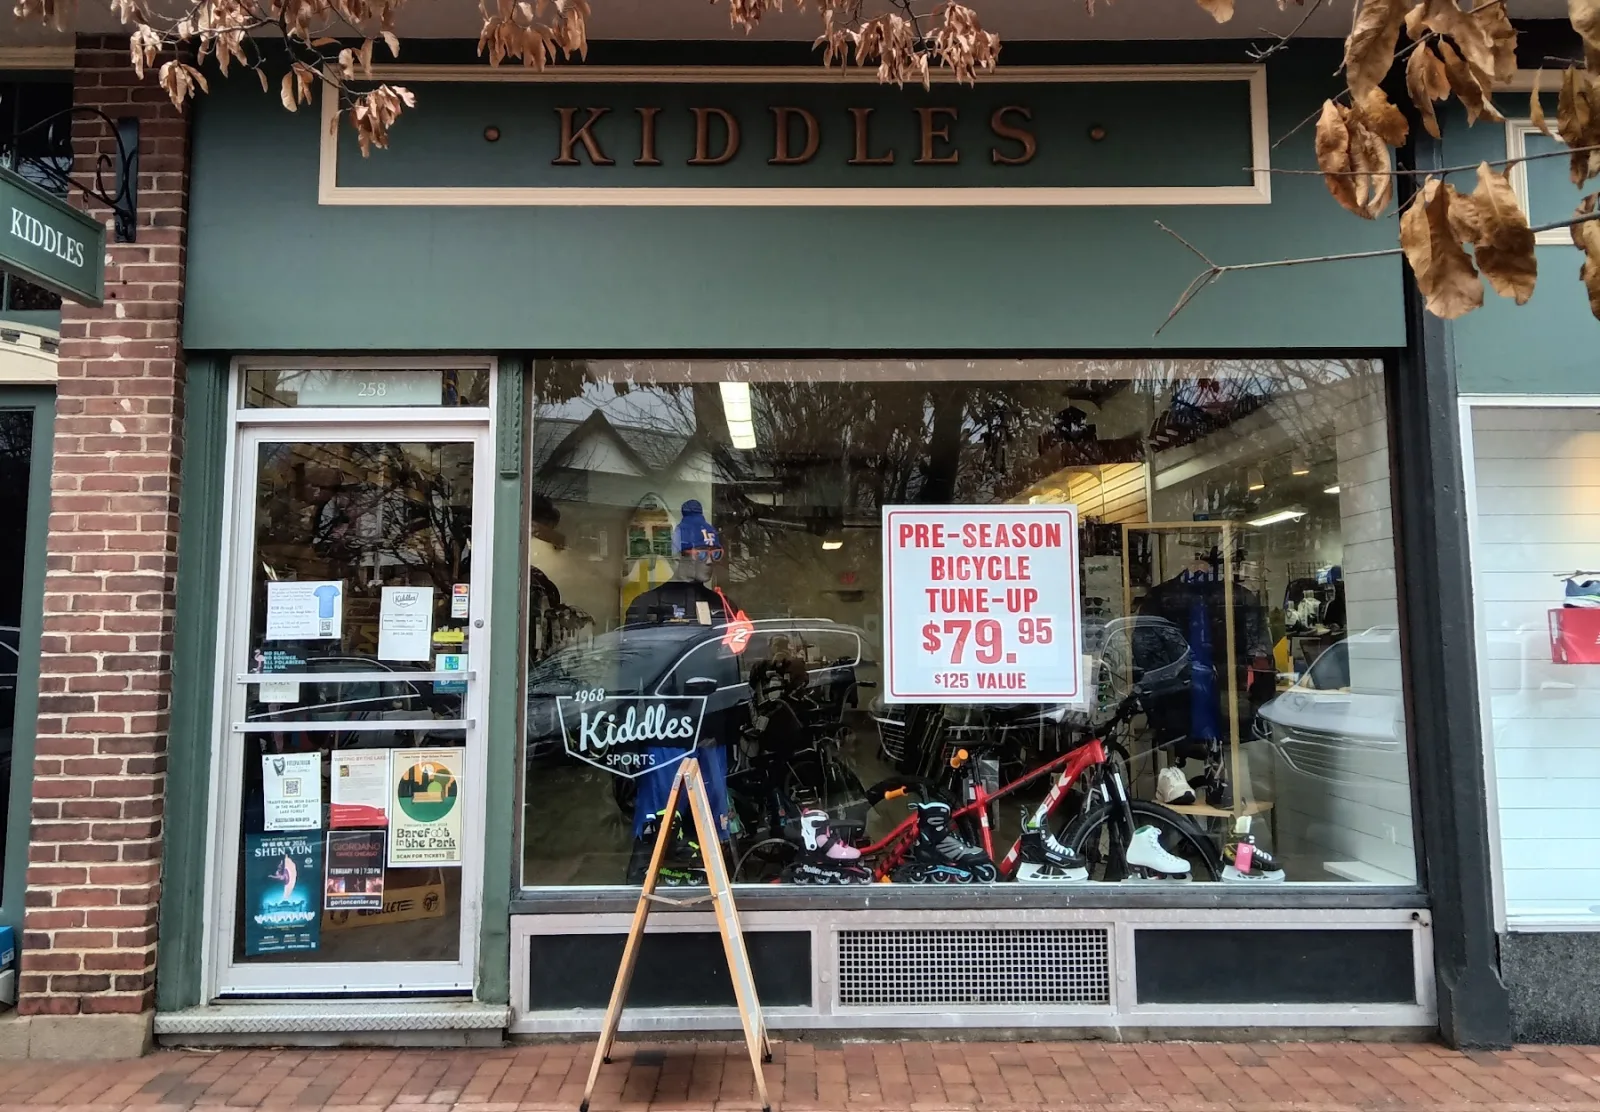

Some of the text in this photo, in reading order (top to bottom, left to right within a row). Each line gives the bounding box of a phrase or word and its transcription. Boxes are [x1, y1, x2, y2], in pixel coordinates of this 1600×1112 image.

[551, 105, 1038, 167] KIDDLES
[10, 207, 84, 268] KIDDLES
[358, 382, 387, 397] 258
[899, 523, 1062, 548] PRE-SEASON
[931, 556, 1031, 581] BICYCLE
[925, 588, 1038, 613] TUNE-UP
[732, 628, 748, 643] 2
[934, 672, 1027, 689] $125 VALUE
[574, 688, 605, 704] 1968
[580, 703, 694, 752] Kiddles
[606, 753, 656, 766] SPORTS
[333, 842, 380, 851] GIORDANO
[405, 838, 425, 848] the
[429, 837, 456, 848] Park
[254, 845, 312, 857] SHEN YUN
